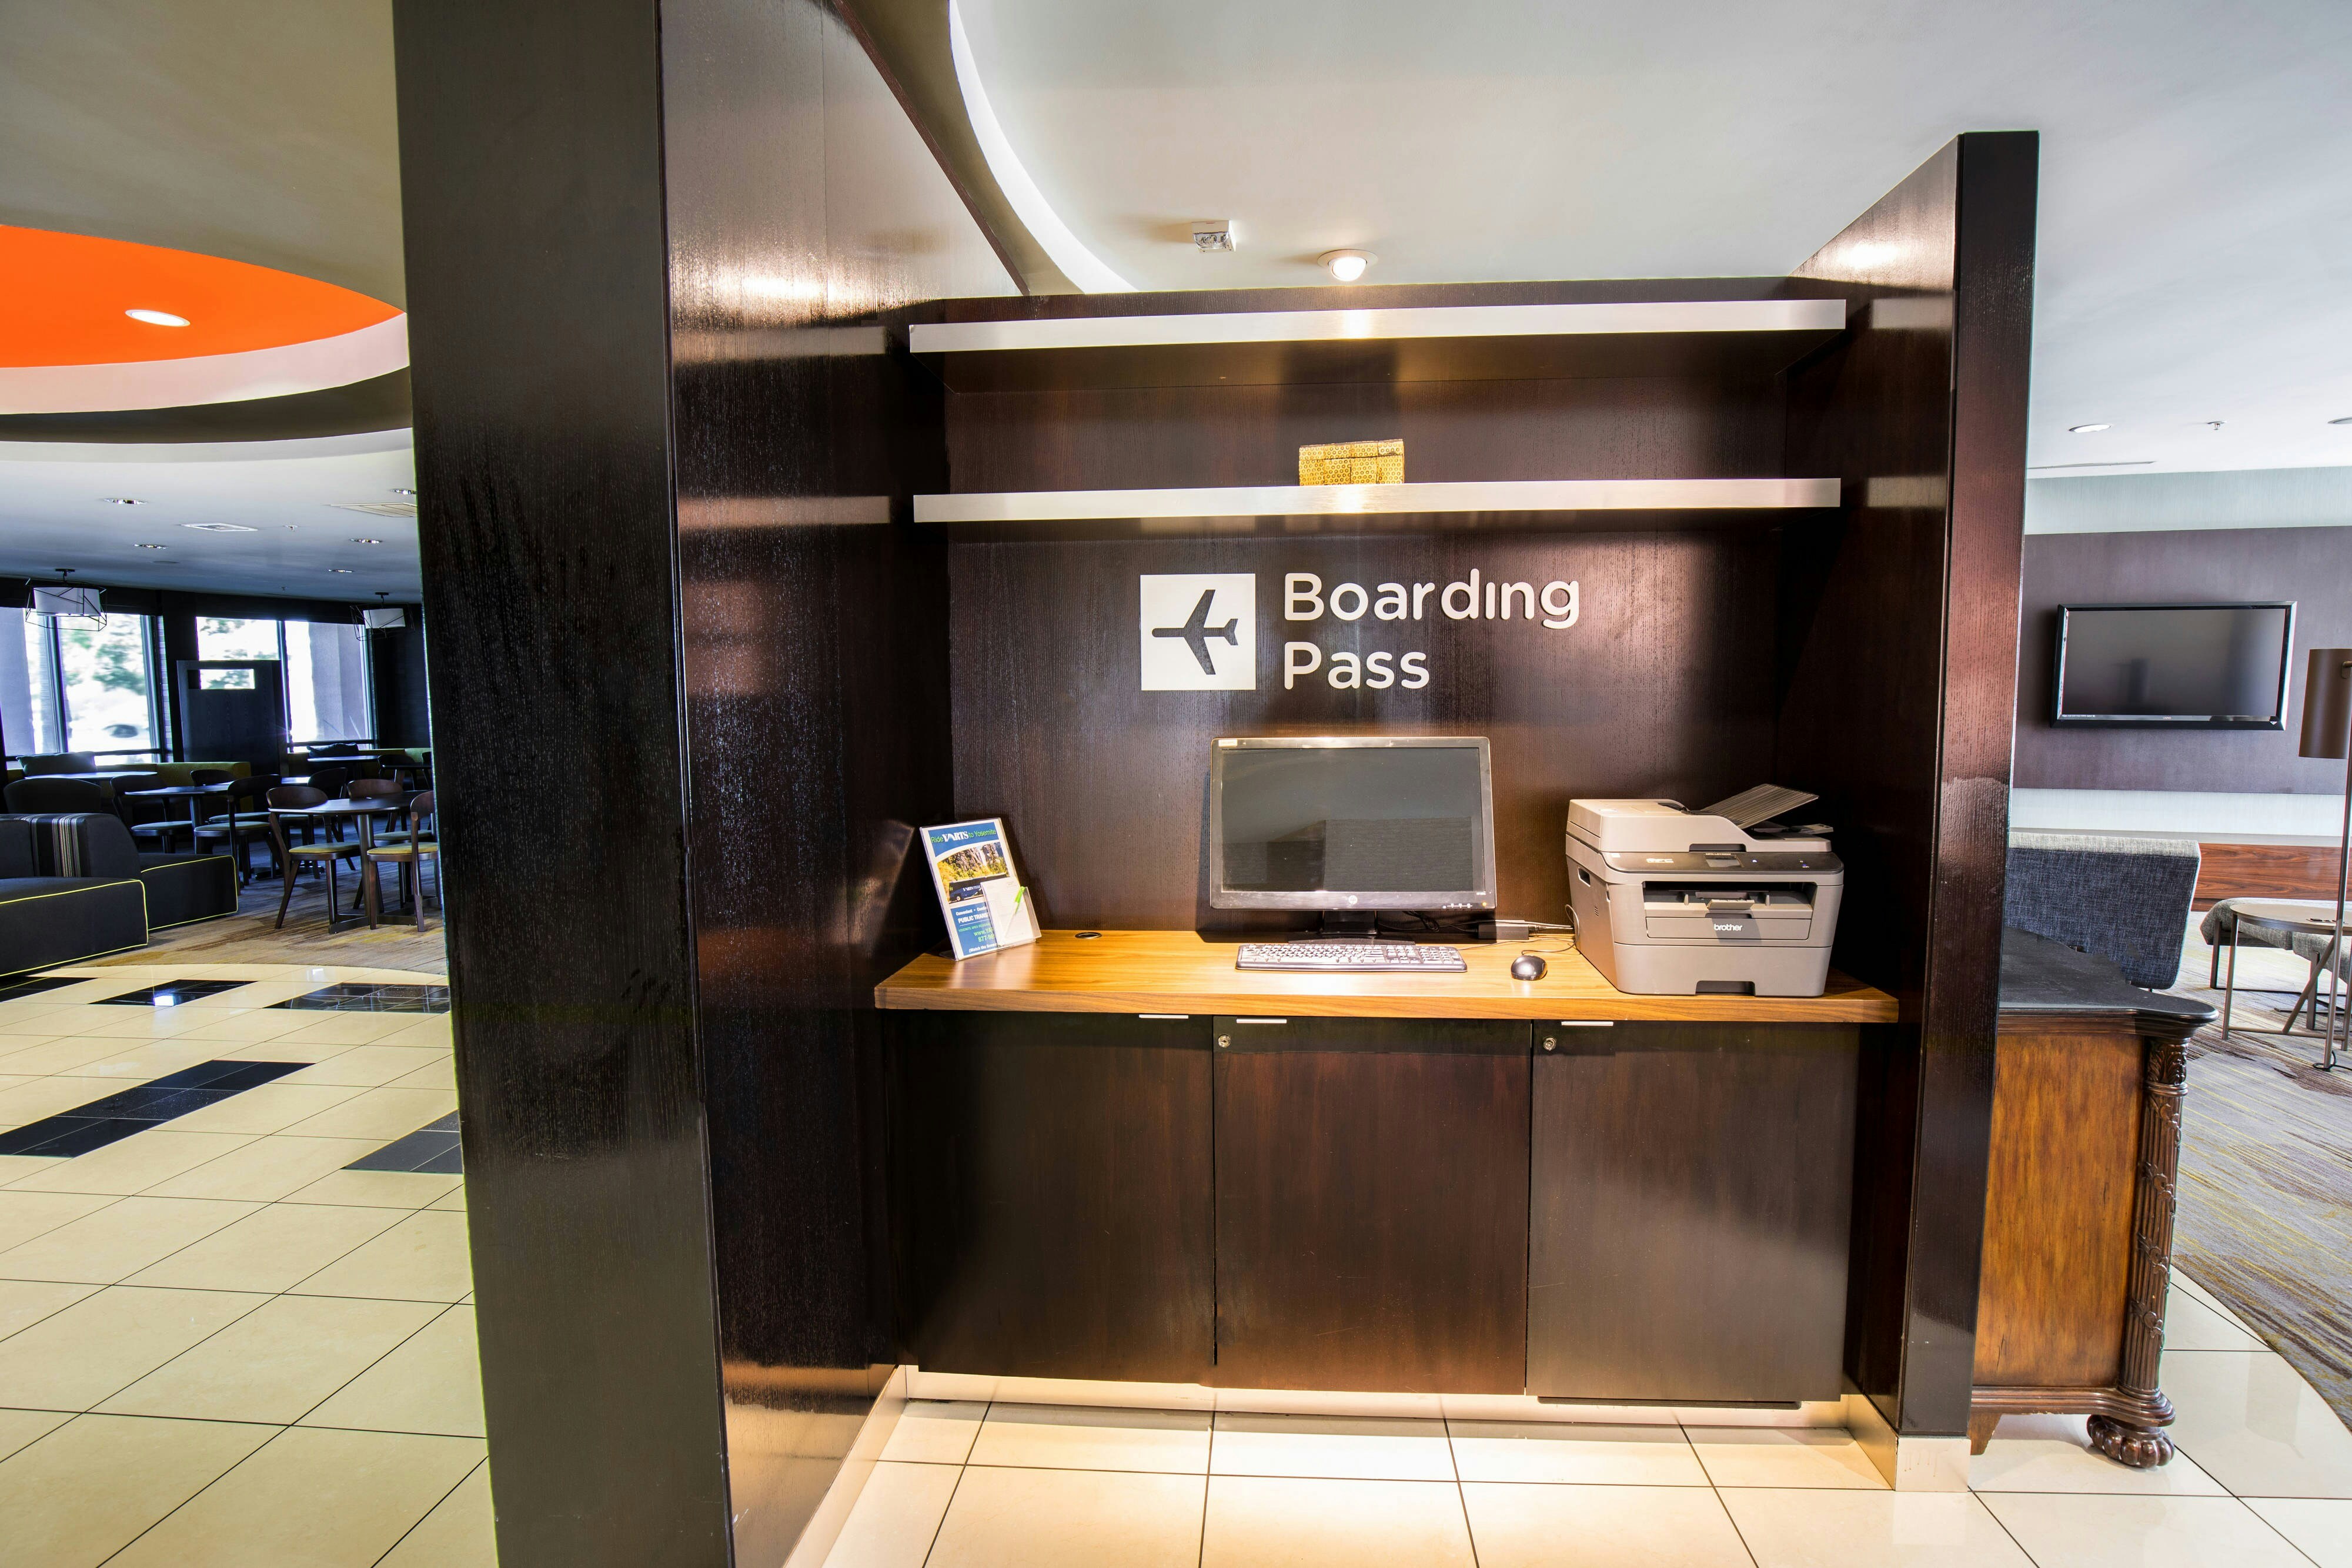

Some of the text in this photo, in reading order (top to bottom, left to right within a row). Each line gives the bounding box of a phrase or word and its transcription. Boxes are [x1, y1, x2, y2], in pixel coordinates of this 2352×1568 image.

[1285, 568, 1579, 629] Boarding
[1284, 641, 1430, 690] Pass
[942, 831, 969, 842] YARTS
[974, 828, 997, 837] Yosemite
[958, 915, 974, 924] PUBLIC
